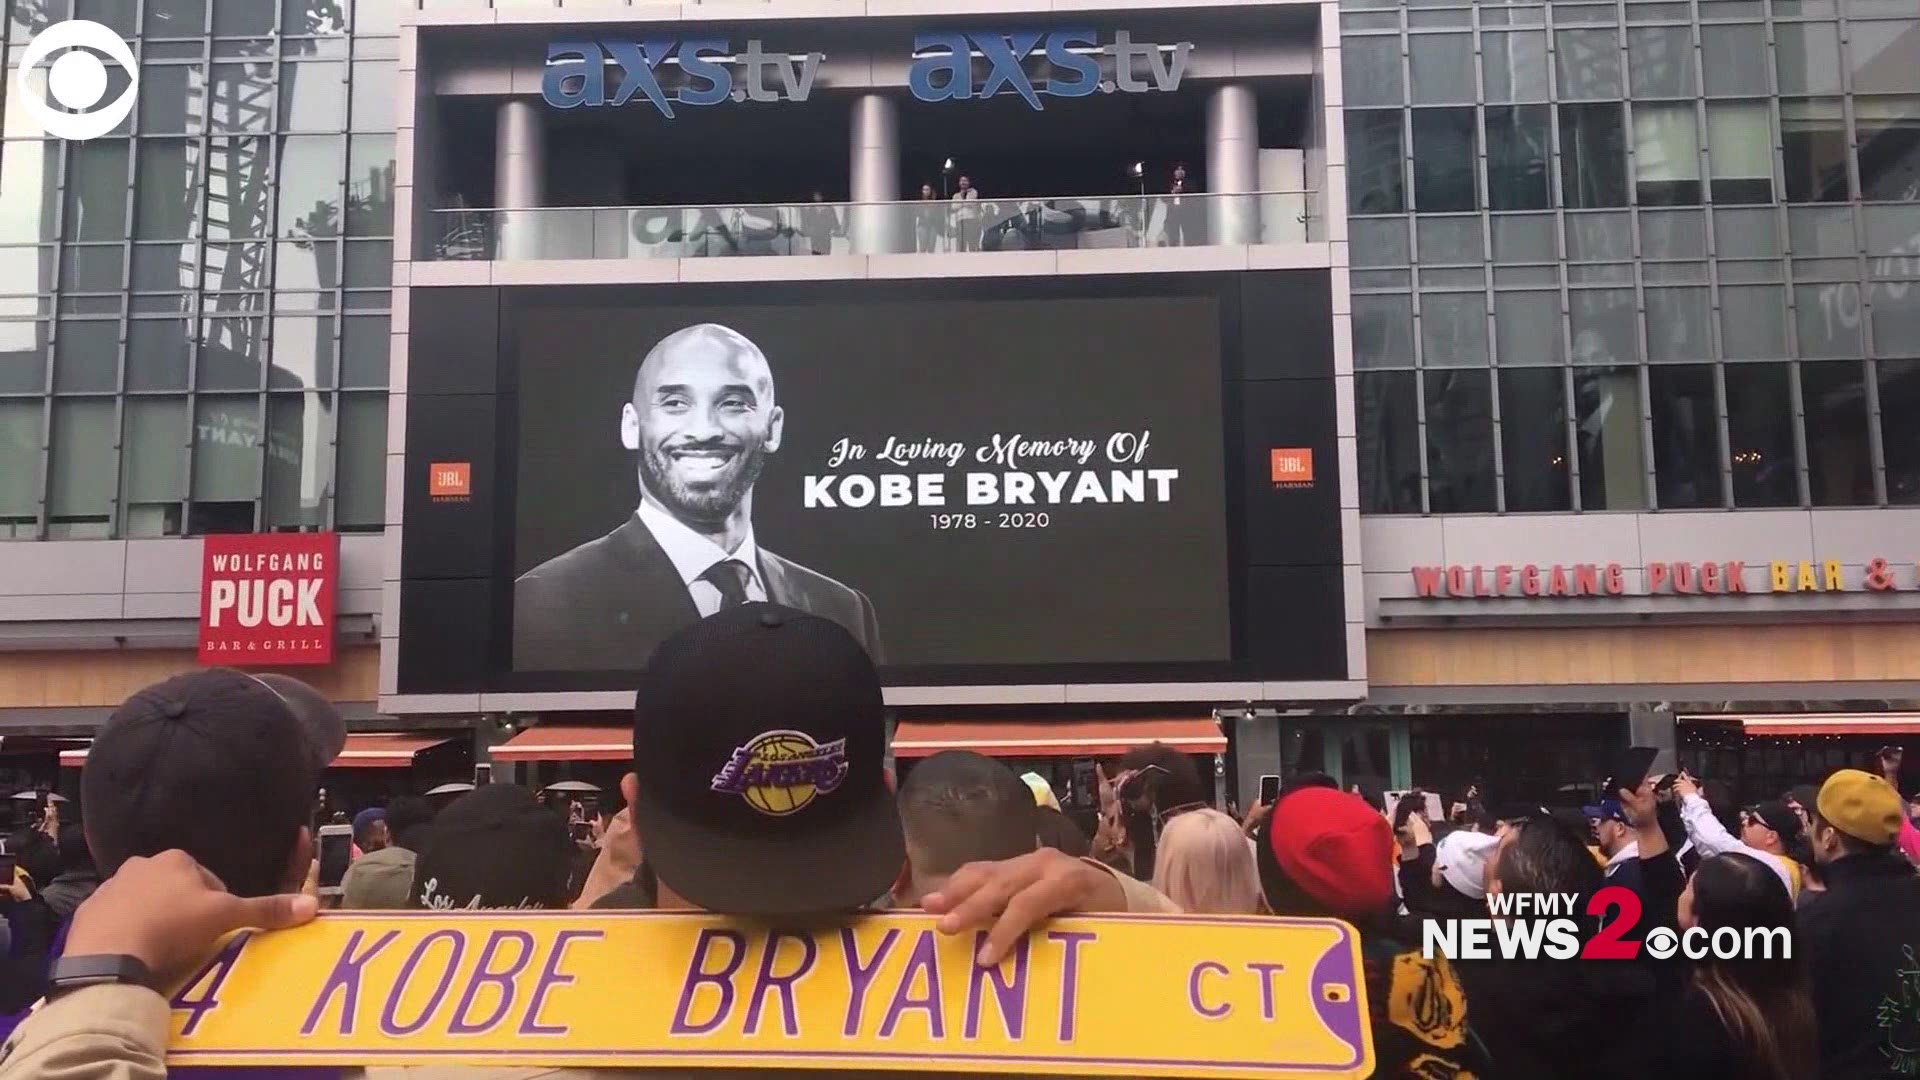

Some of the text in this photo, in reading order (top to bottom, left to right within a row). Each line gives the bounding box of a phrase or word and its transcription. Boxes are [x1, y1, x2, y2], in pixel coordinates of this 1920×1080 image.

[541, 38, 824, 119] axs.tv
[909, 29, 1194, 111] axs.tv
[828, 430, 1150, 470] In Loving Memory Of
[1279, 456, 1306, 473] JBL
[437, 471, 464, 487] JBL
[803, 468, 1179, 508] KOBE BRYANT
[930, 513, 977, 529] 1978
[998, 512, 1050, 528] 2020
[212, 552, 324, 573] WOLFGANG
[1411, 557, 1896, 596] WOLFGANG PUCK BAR &
[208, 577, 325, 628] PUCK
[206, 639, 323, 651] BAR & GRILL
[298, 928, 606, 1038] KOBE
[667, 927, 1098, 1044] BRYANT
[1187, 960, 1285, 1022] CT
